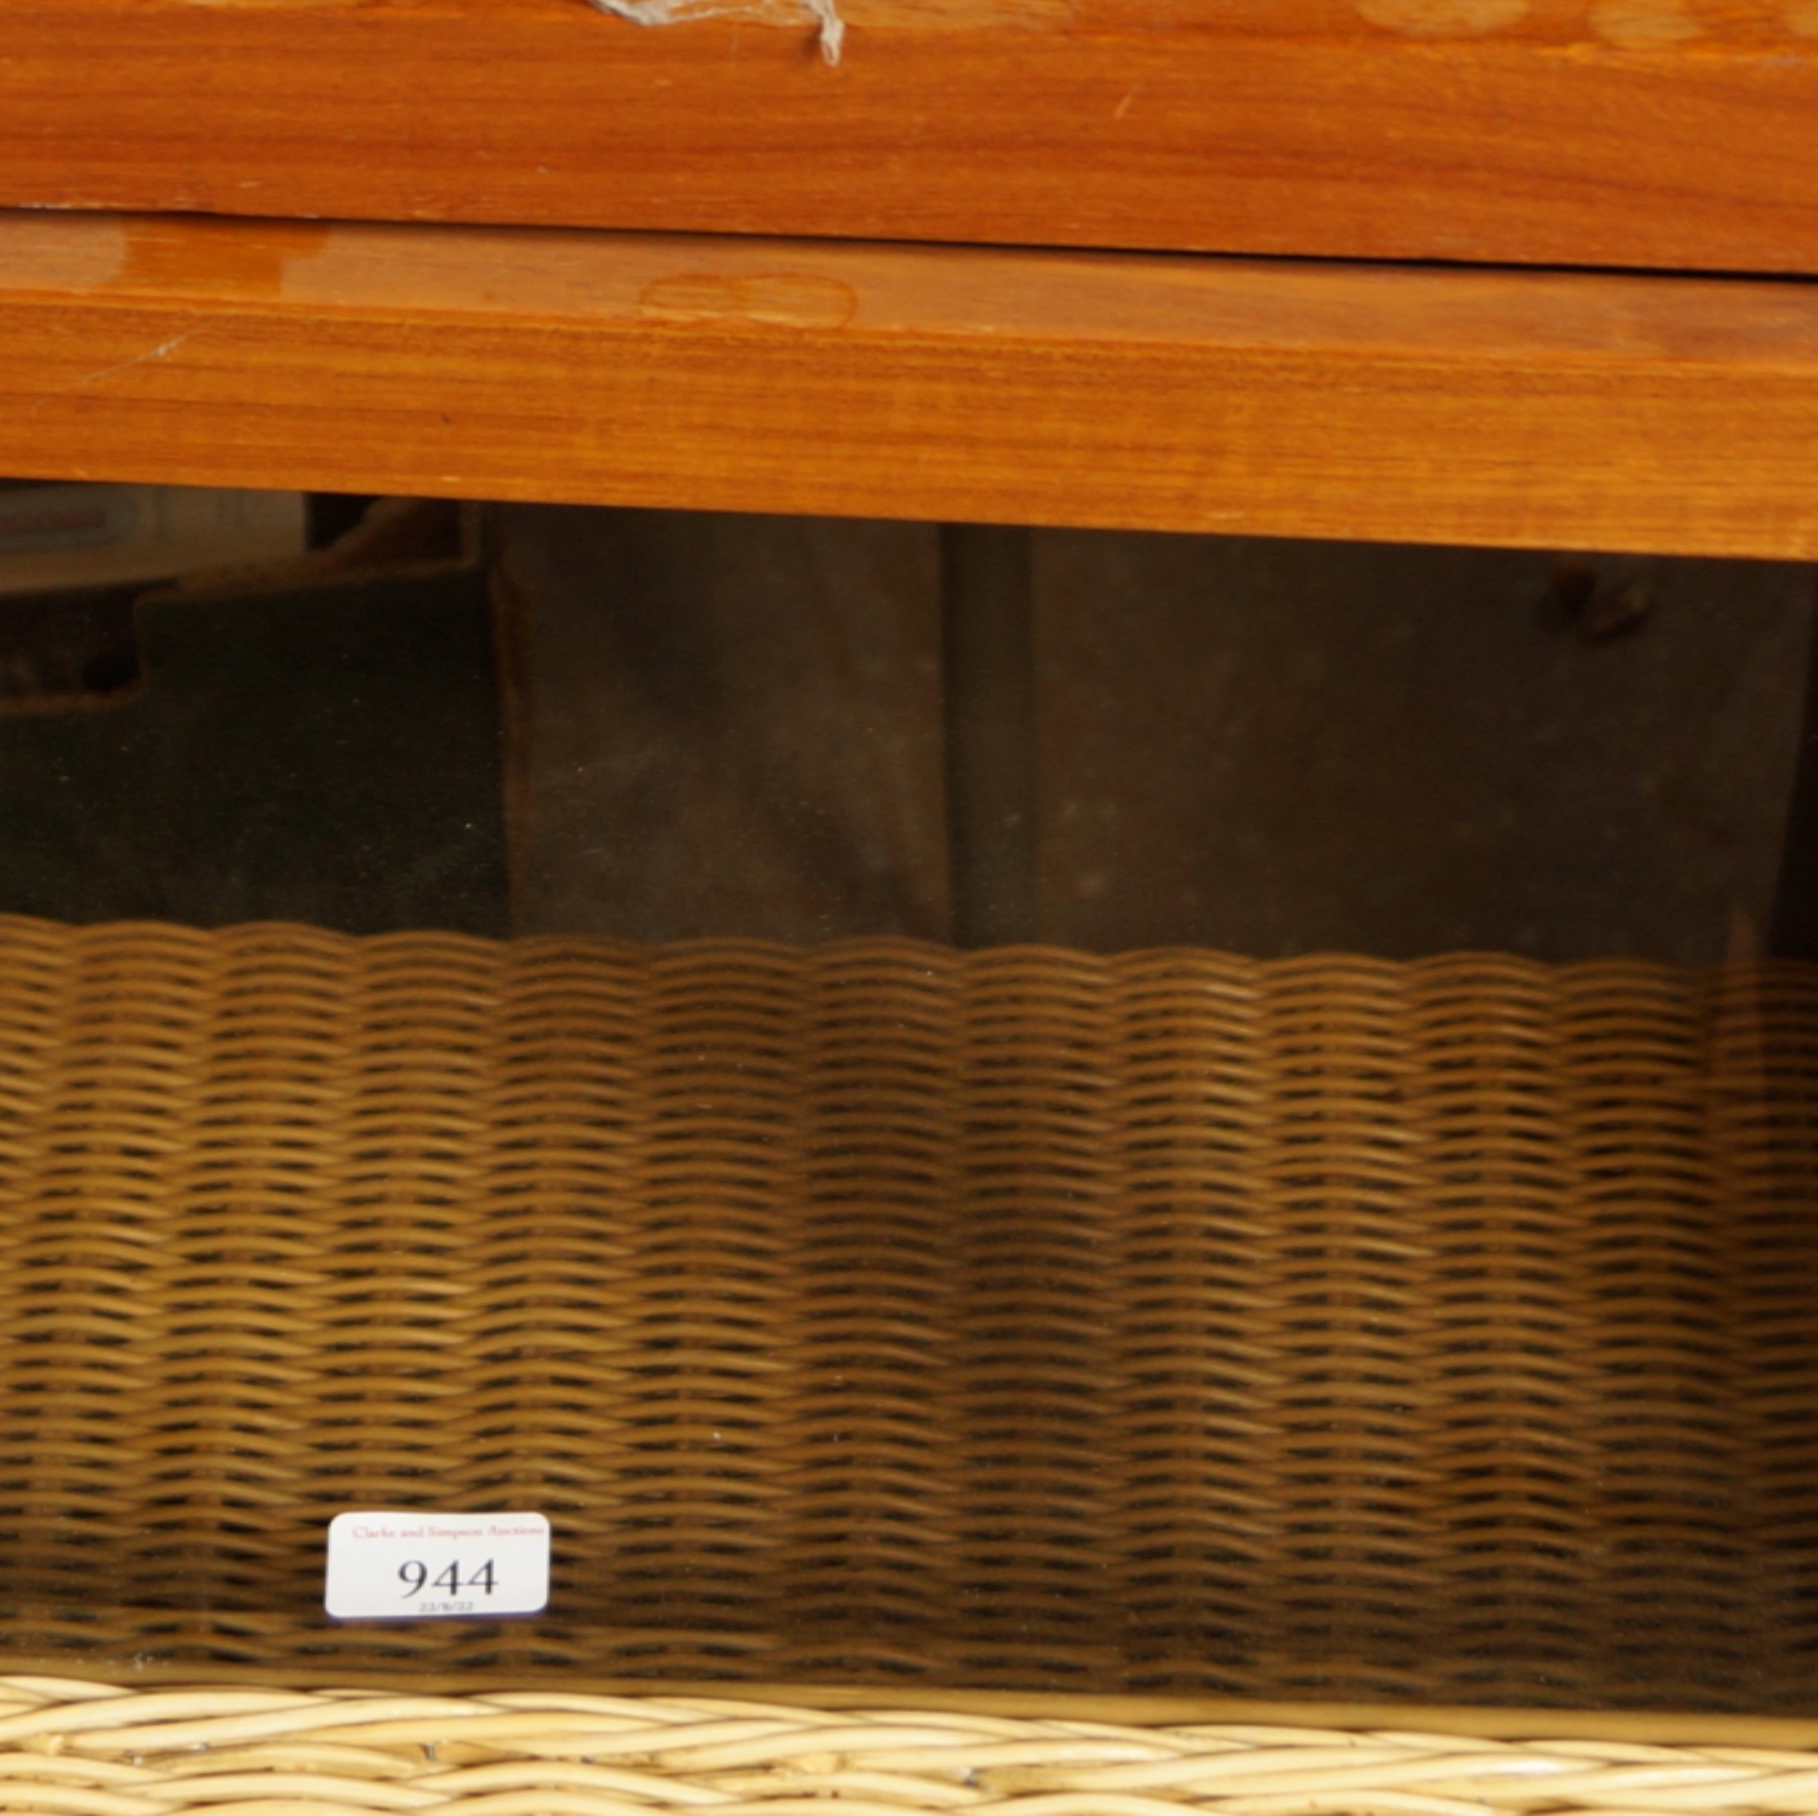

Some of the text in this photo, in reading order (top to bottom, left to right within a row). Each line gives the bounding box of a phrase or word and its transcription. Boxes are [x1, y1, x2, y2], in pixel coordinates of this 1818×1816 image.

[352, 1524, 545, 1541] Clarke and Simpson Auctions
[397, 1557, 499, 1600] 944
